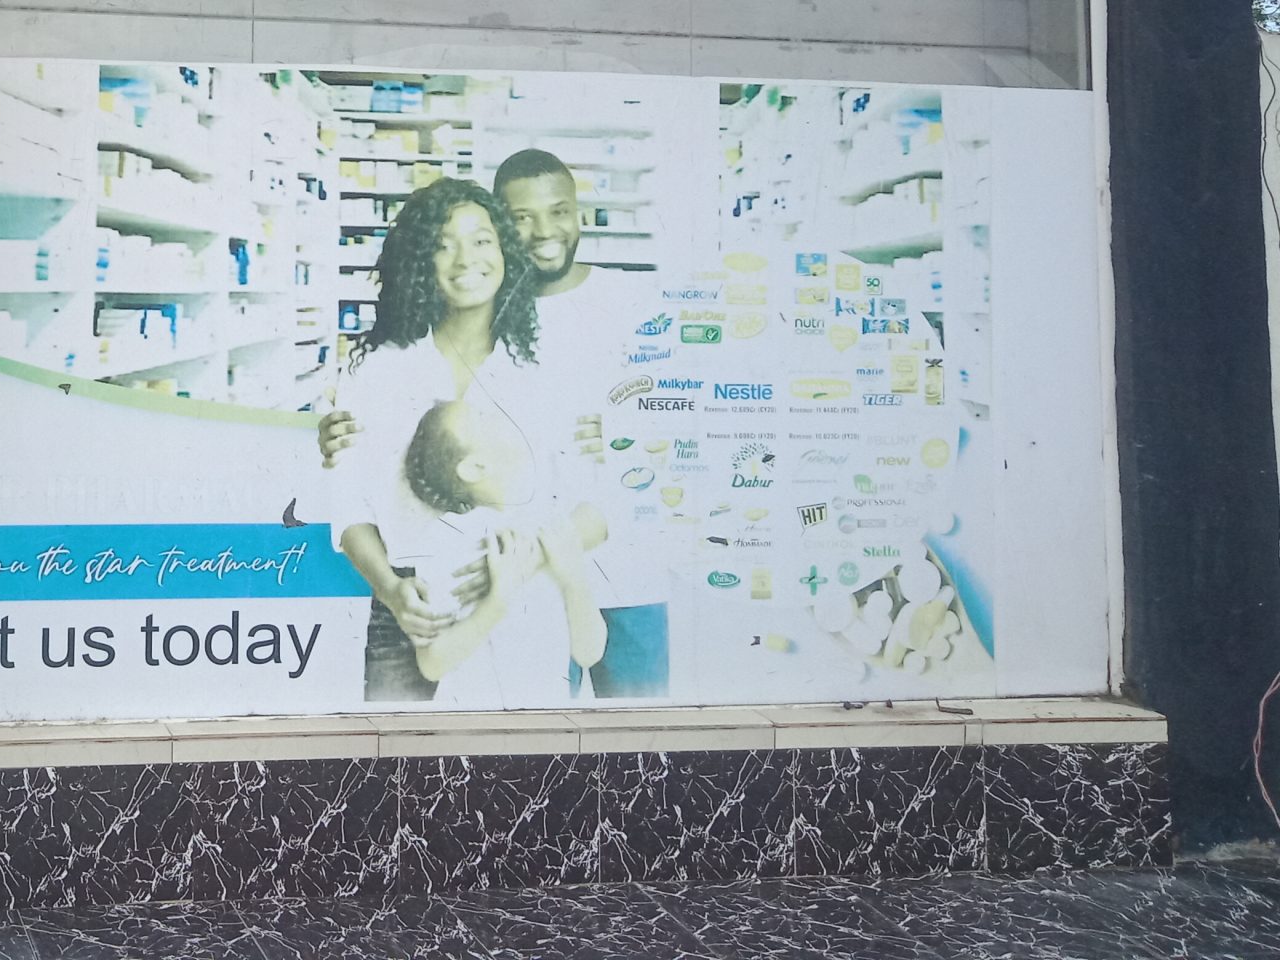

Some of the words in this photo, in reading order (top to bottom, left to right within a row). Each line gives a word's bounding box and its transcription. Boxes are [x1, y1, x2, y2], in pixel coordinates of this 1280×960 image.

[794, 318, 825, 328] nutri
[627, 349, 671, 365] Milkmaid
[856, 367, 885, 376] marie
[657, 378, 705, 391] Milkybar
[862, 394, 903, 406] TIGER
[876, 455, 911, 466] new
[731, 473, 774, 488] Dabur
[800, 505, 826, 526] HIT
[863, 545, 901, 557] Stella
[36, 543, 79, 581] the
[84, 548, 154, 583] star
[158, 542, 308, 587] treatment!
[41, 625, 116, 668] us
[140, 610, 322, 679] today
